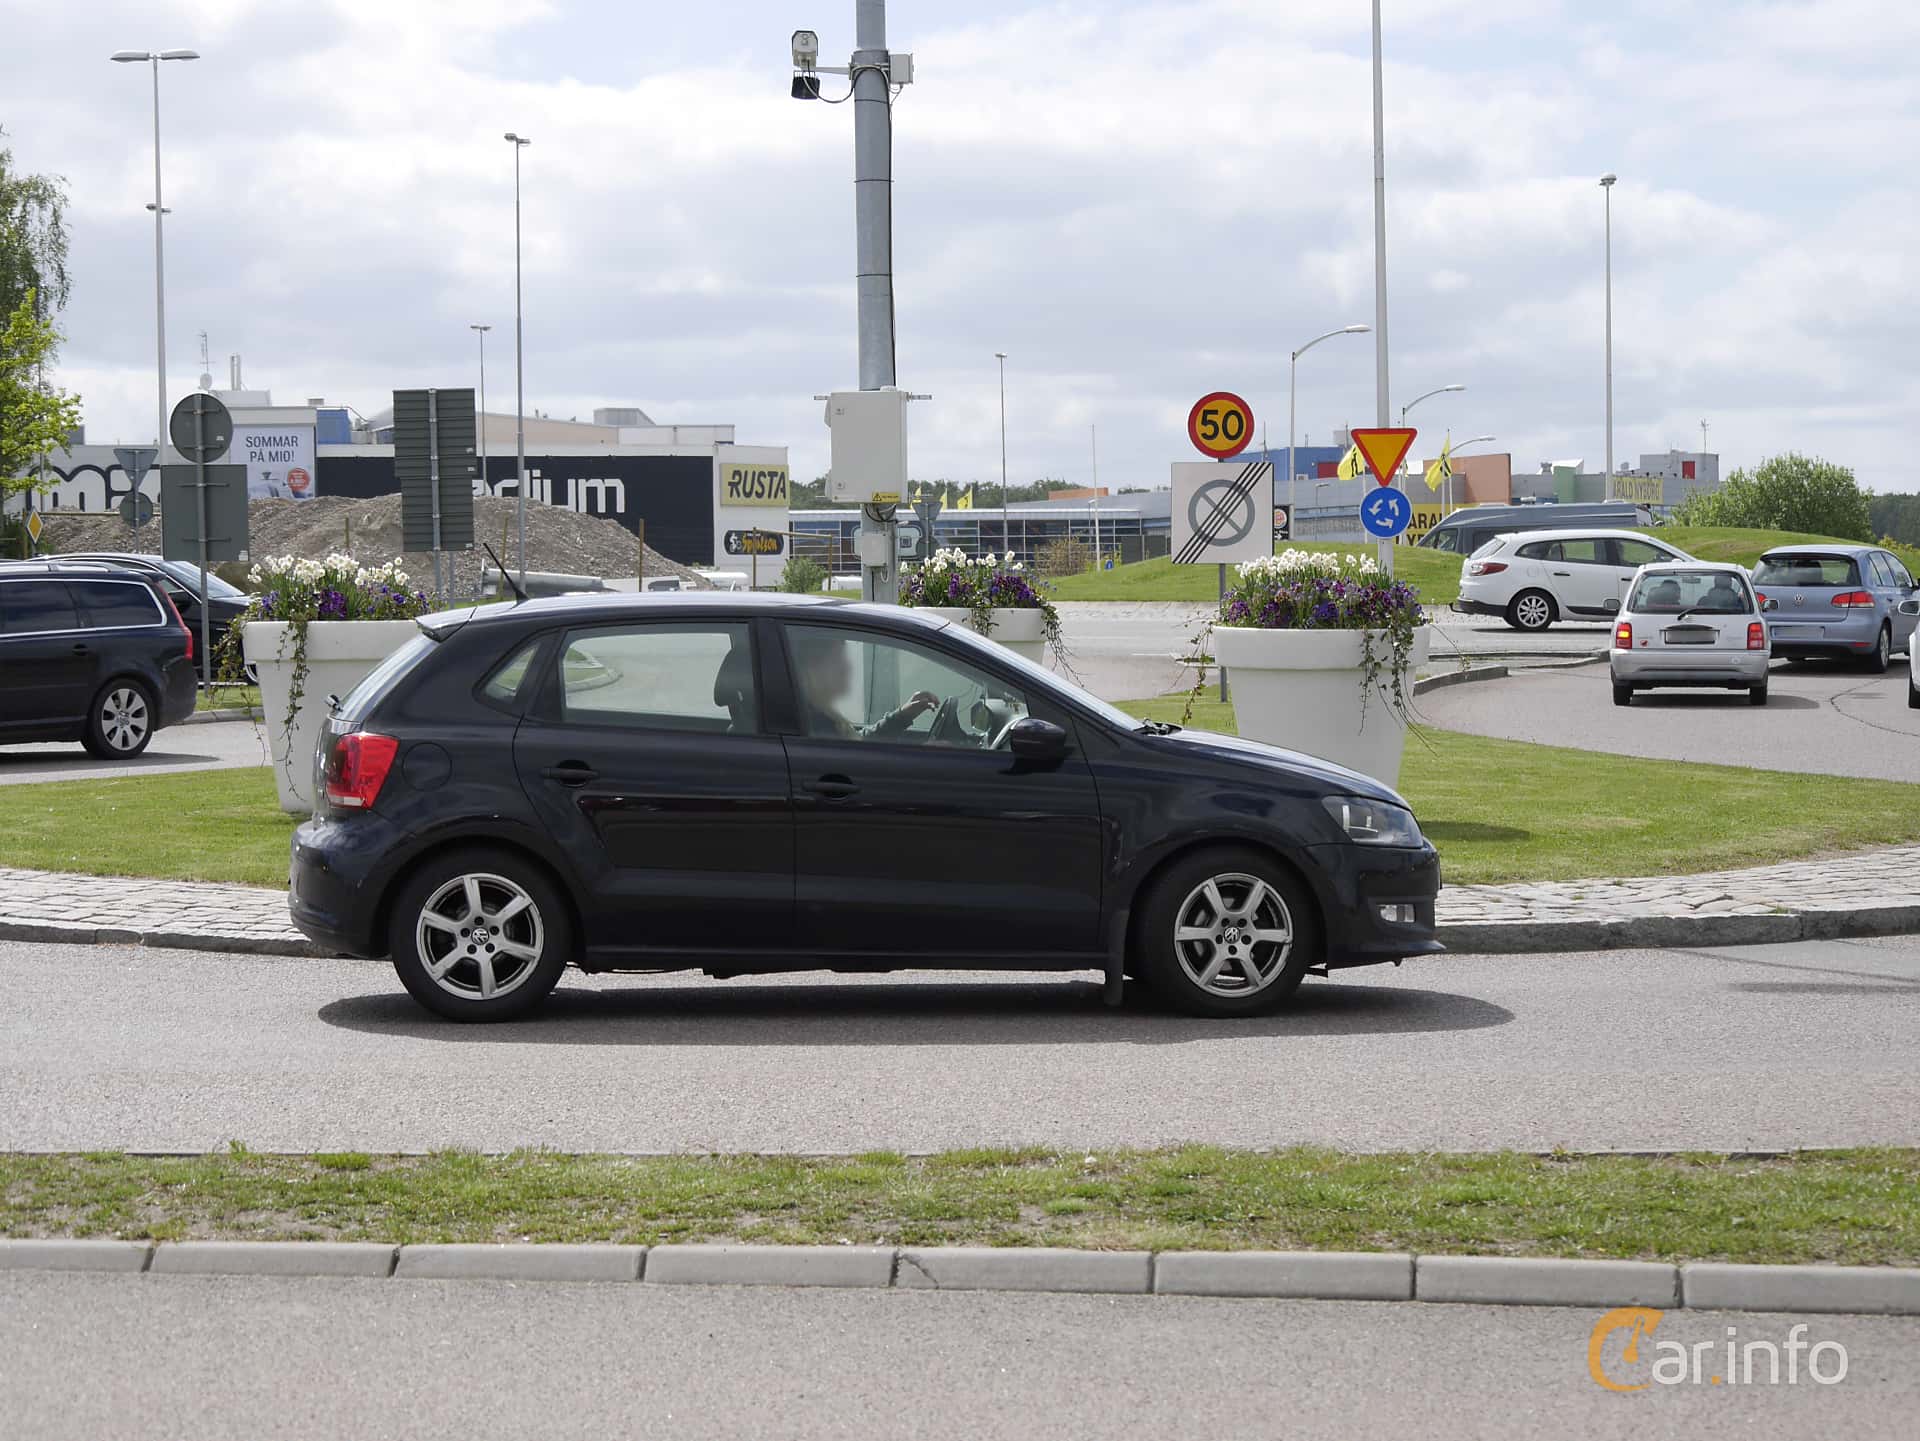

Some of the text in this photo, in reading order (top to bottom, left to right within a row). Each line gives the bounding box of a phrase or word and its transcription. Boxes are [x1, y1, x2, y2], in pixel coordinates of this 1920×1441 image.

[1201, 409, 1244, 441] 50
[245, 435, 299, 448] SOMMAR
[250, 448, 295, 462] PÅ MIO!
[472, 469, 625, 513] dium
[727, 470, 787, 499] RUSTA
[1407, 513, 1443, 529] ARA
